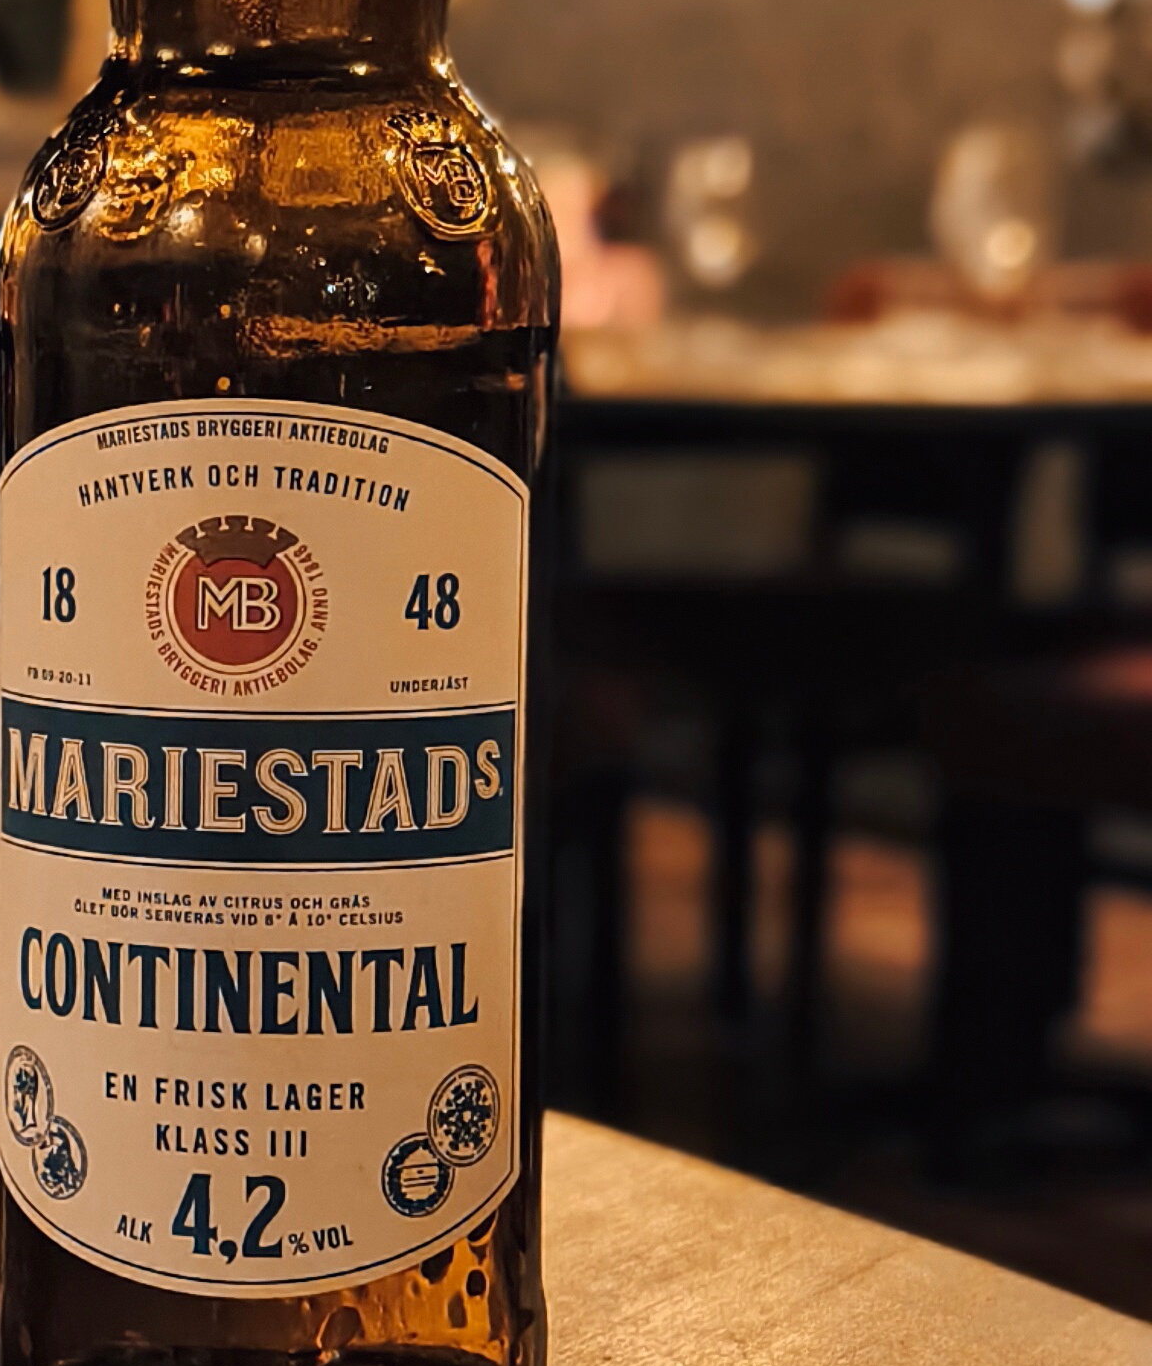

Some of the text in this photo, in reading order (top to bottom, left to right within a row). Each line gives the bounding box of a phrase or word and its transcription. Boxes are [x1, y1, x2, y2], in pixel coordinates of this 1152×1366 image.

[97, 419, 390, 454] MARIESTADS BRYGGERI AKTIEBOLAG
[79, 464, 410, 512] HANTVERK OCH TRADITION
[41, 566, 77, 623] 18
[404, 572, 461, 631] 48
[158, 642, 227, 696] BRYGGERI
[311, 587, 329, 633] ANNO
[102, 887, 132, 902] MED
[137, 890, 192, 907] INSLAG
[199, 895, 217, 907] AV
[223, 896, 283, 910] CITRUS
[290, 897, 323, 910] OCH
[144, 908, 225, 925] SERVERAS
[230, 912, 258, 926] VID
[338, 911, 404, 926] CELSIUS
[19, 926, 480, 1035] CONTINENTAL
[105, 1071, 365, 1111] EN FRISK LAGER
[155, 1123, 308, 1158] KLASS III
[116, 1214, 153, 1244] ALK
[171, 1173, 286, 1265] 4,2
